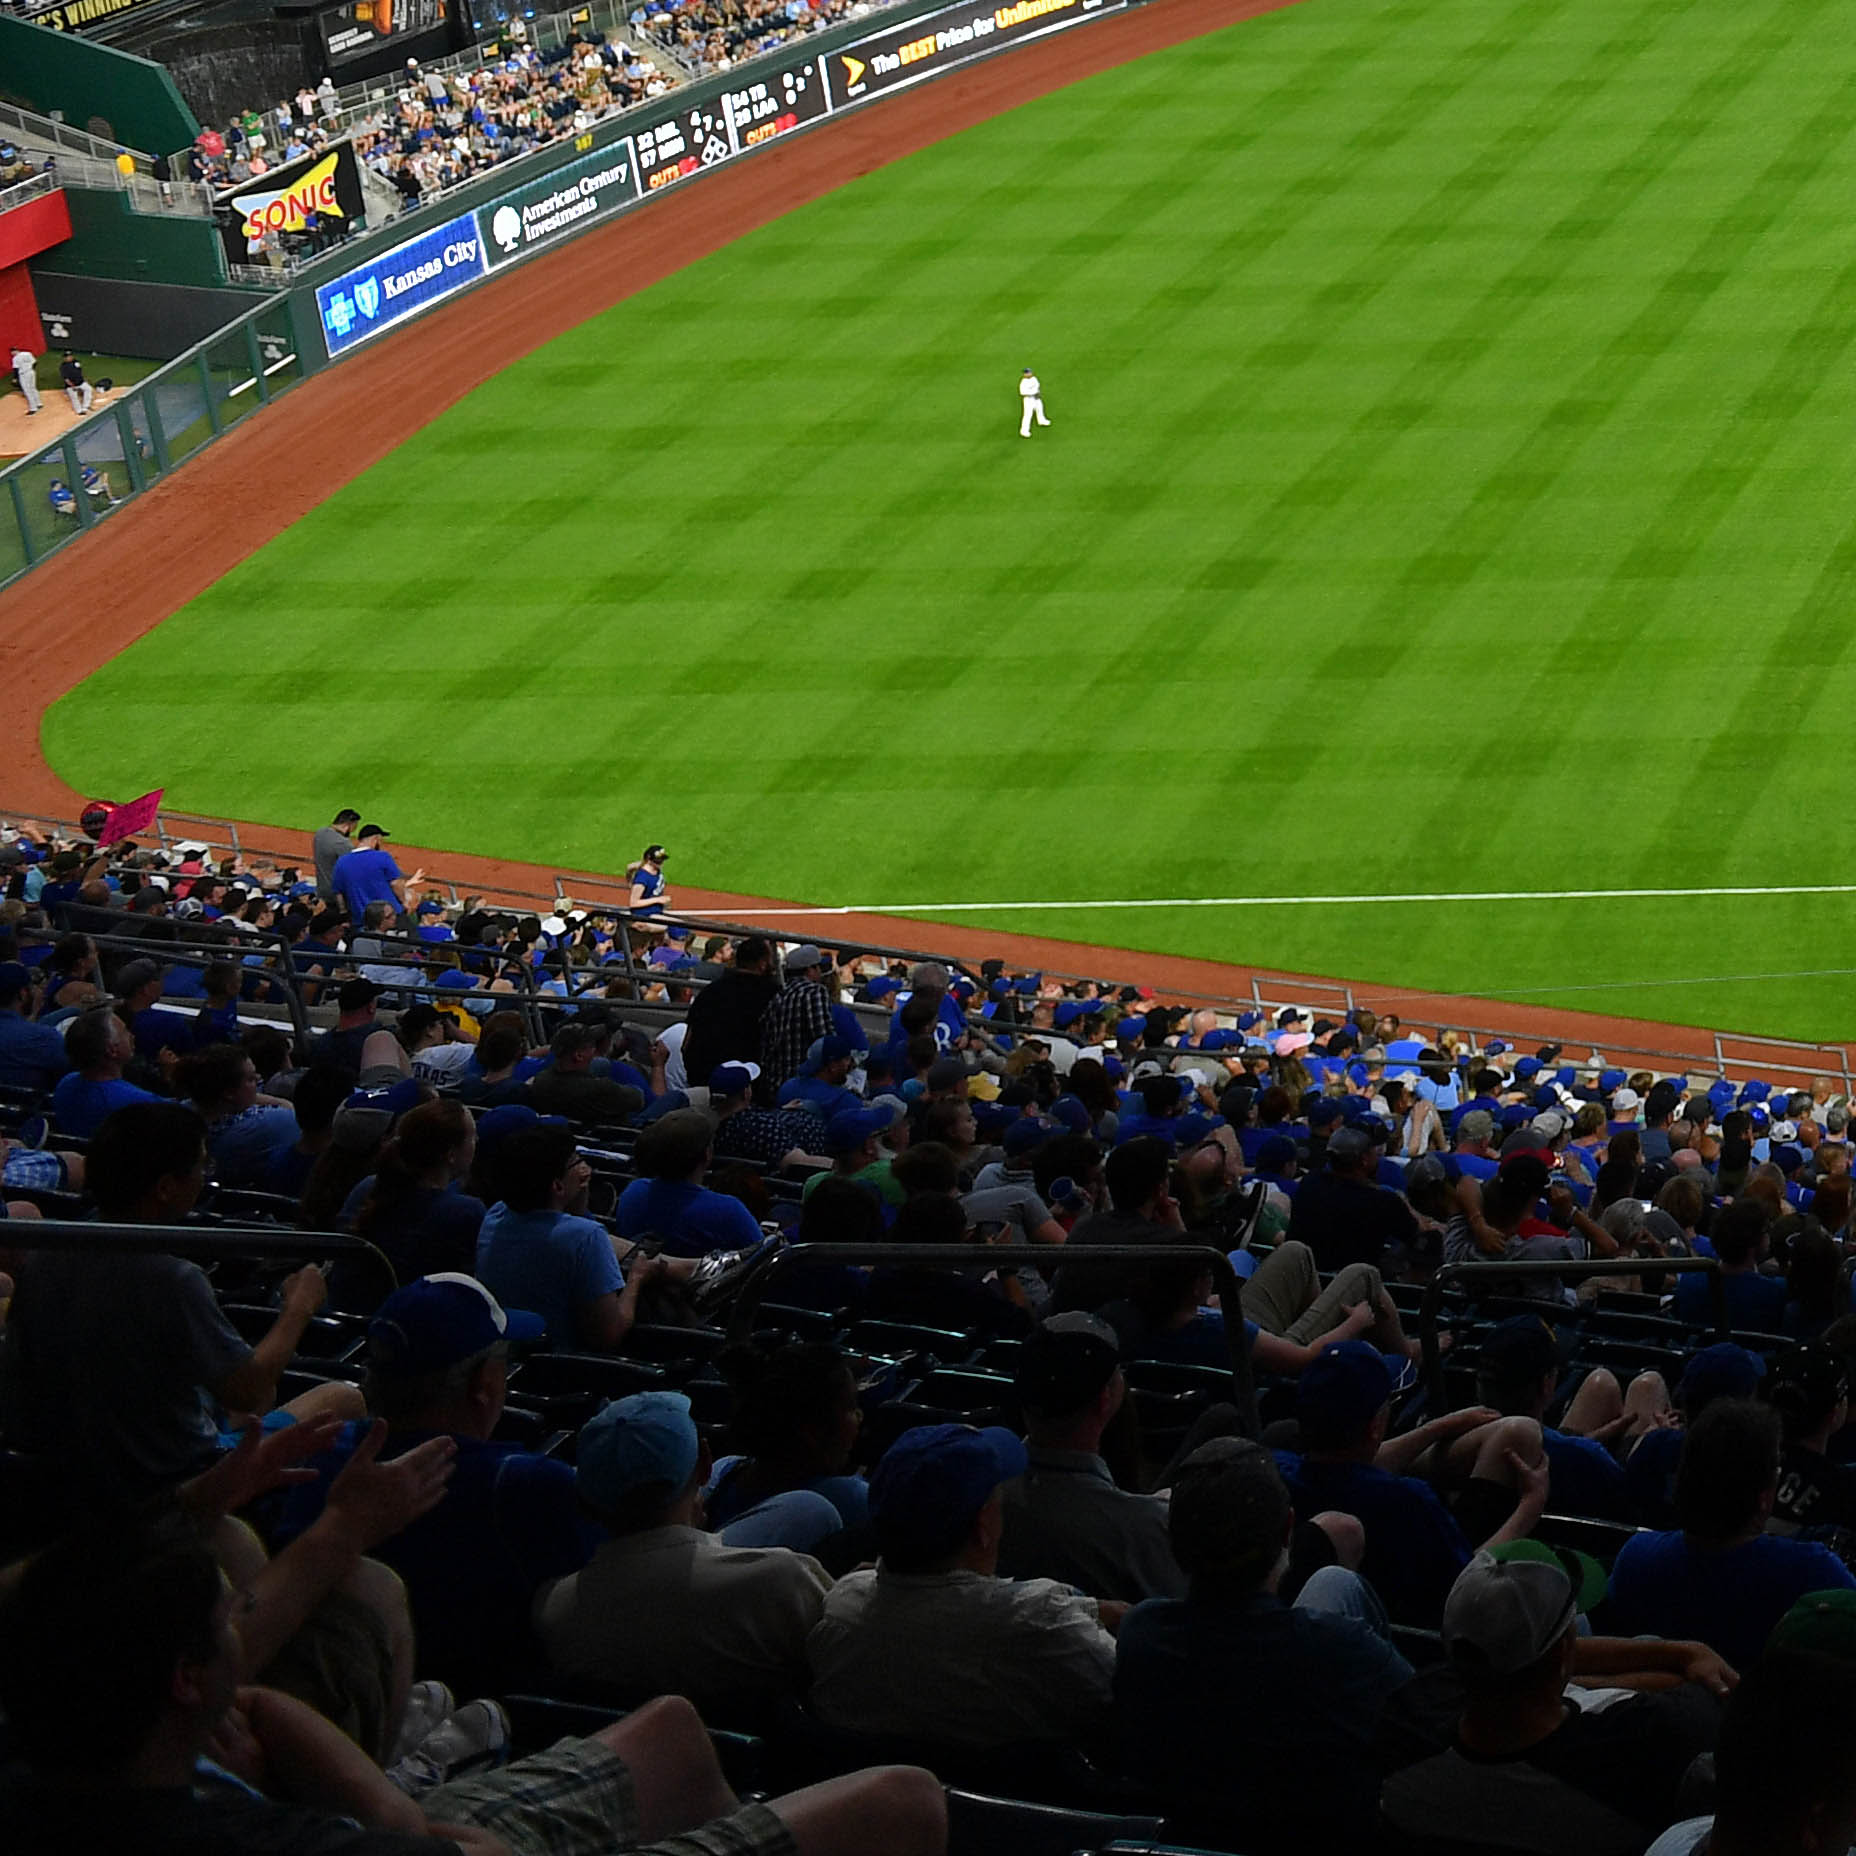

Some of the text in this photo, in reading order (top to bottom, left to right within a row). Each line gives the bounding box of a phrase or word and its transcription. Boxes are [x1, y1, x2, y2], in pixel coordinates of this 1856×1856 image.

[871, 54, 900, 75] The
[898, 35, 936, 65] BEST
[936, 24, 973, 51] Price
[973, 16, 995, 37] for
[248, 175, 335, 241] SONIC
[520, 162, 629, 225] American Century
[524, 195, 599, 243] Investments
[382, 238, 478, 300] Kansas City
